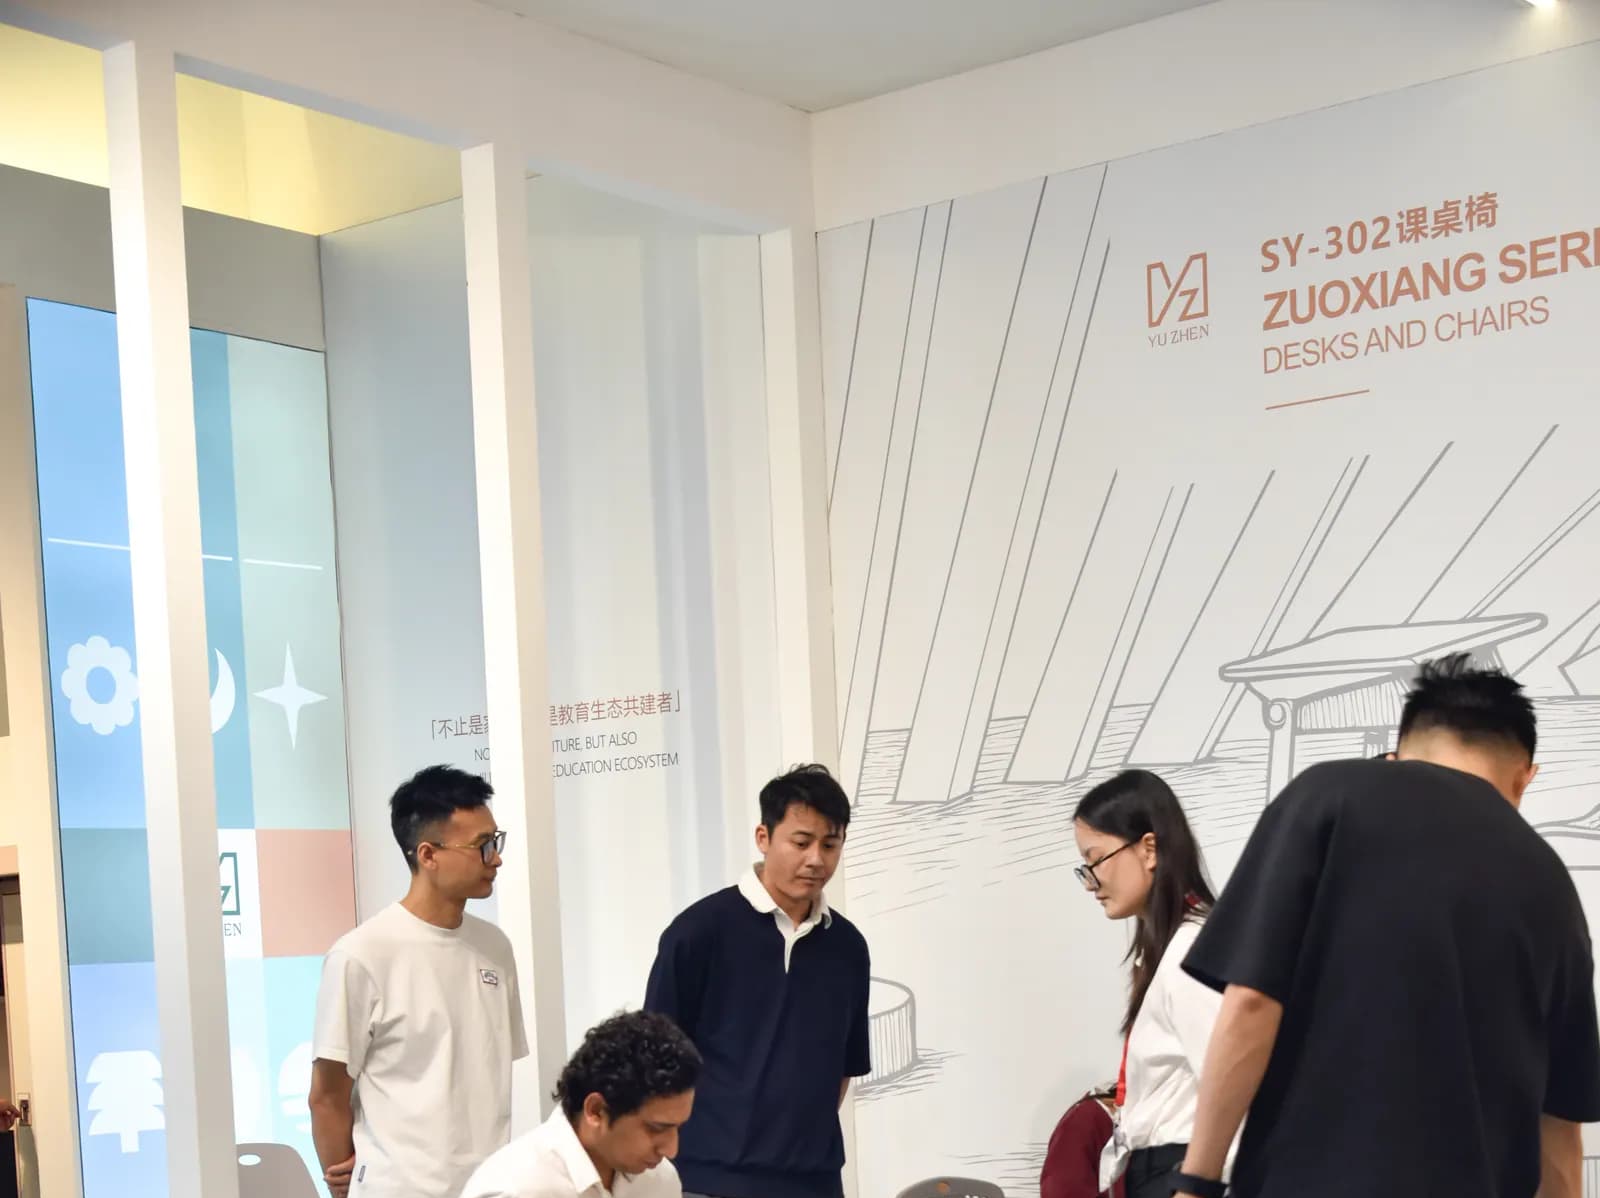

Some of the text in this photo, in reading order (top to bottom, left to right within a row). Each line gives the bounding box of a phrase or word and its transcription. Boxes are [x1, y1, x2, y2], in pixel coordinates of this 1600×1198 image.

[1261, 191, 1498, 273] SY-302课桌椅
[1263, 226, 1600, 331] ZUOXIANG SERI
[1148, 323, 1209, 348] YU ZHEN
[1263, 295, 1550, 374] DESKS AND CHAIRS
[431, 714, 489, 741] 「不止是
[474, 731, 638, 761] NO ITURE, BUT ALSO
[614, 752, 679, 772] ECOSYSTEM
[223, 922, 242, 937] EN
